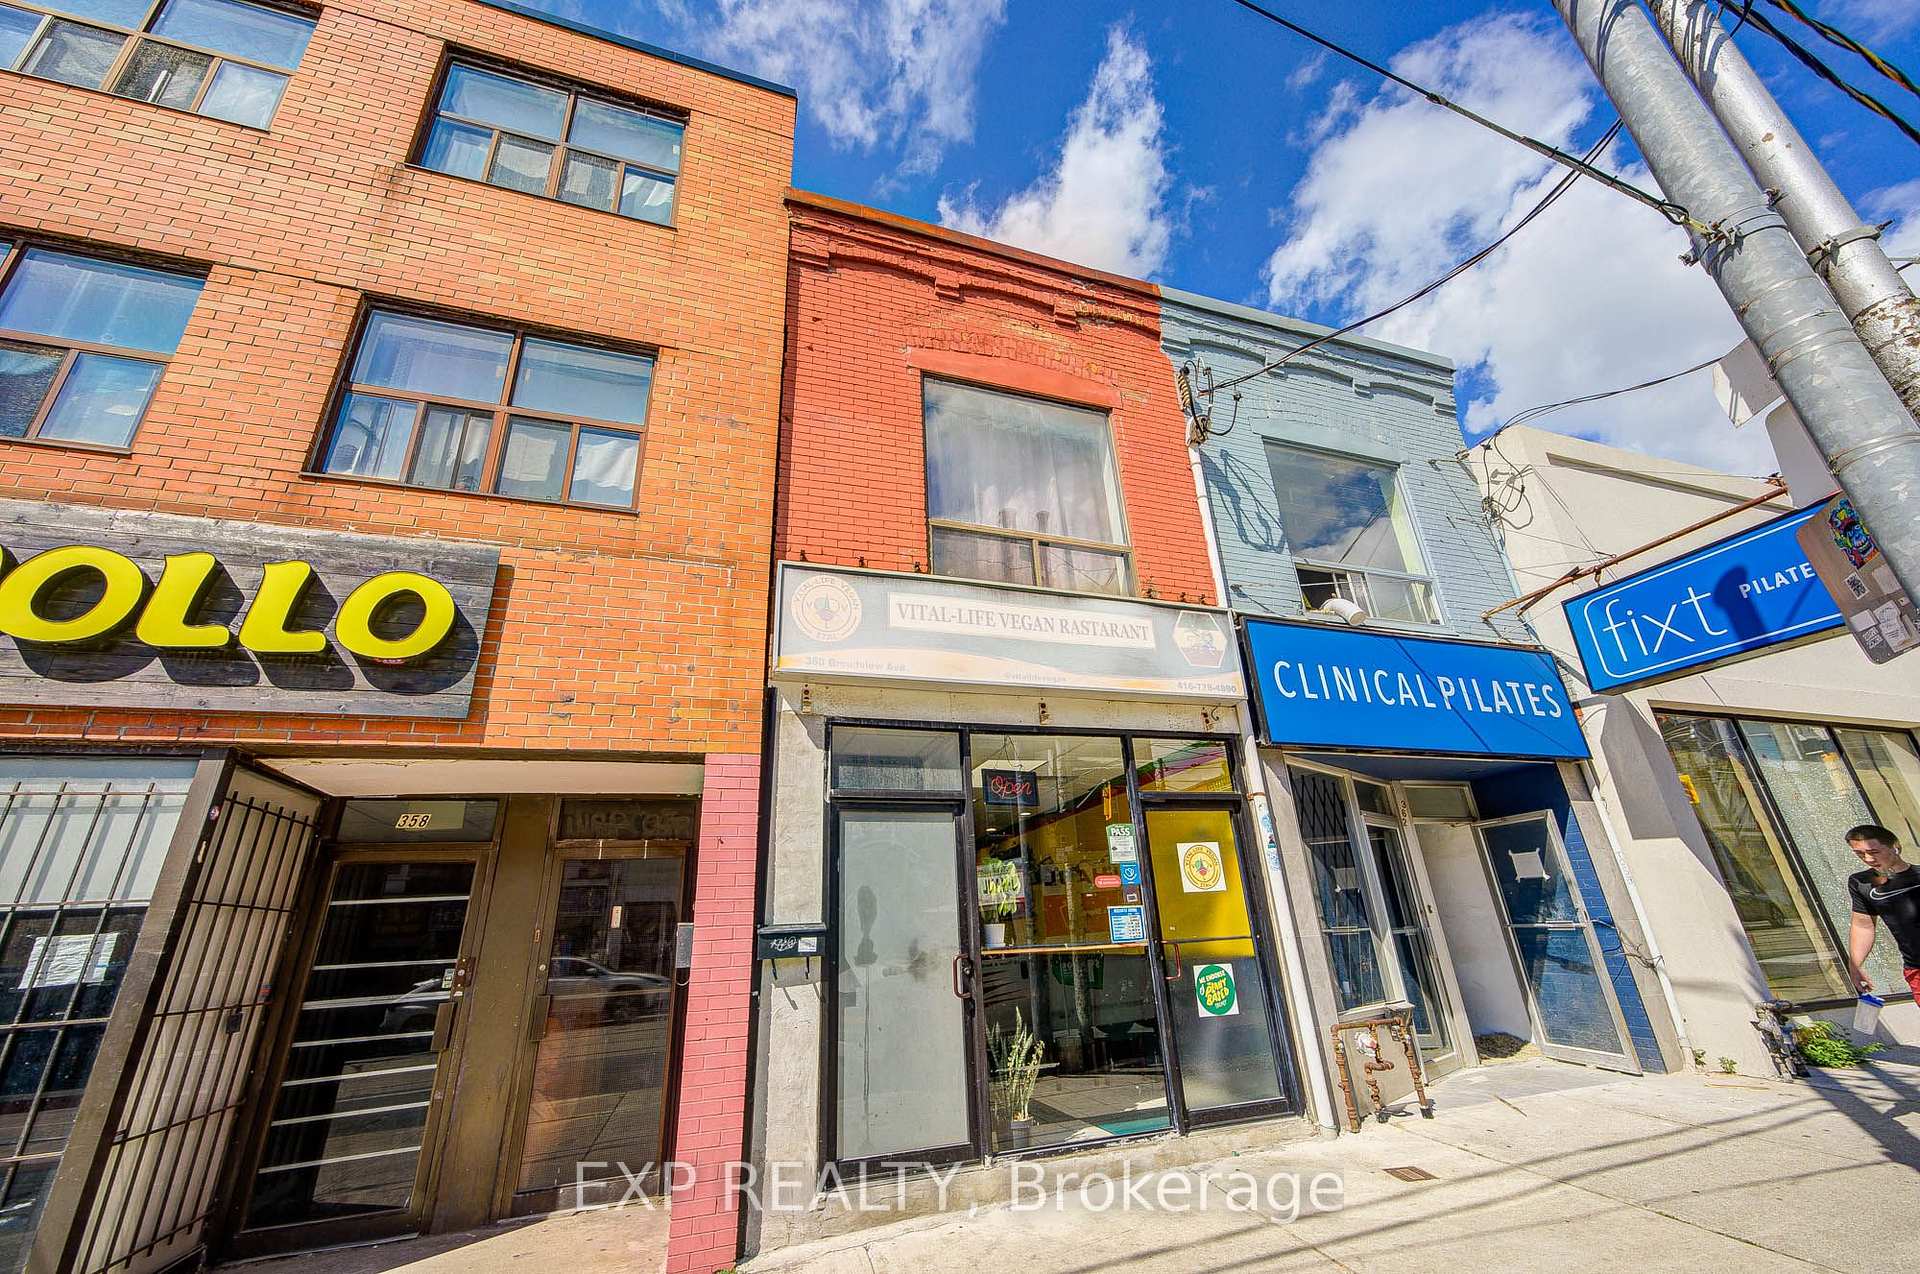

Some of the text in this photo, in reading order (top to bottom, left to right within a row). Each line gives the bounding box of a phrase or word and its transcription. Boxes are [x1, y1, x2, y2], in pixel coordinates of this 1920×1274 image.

[1738, 562, 1818, 599] PILATE
[0, 544, 457, 660] OLLO
[896, 602, 1149, 642] VITAL-LIFE VEGAN RASTARANT
[1602, 586, 1728, 662] fixt
[1273, 660, 1562, 719] CLINICAL PILATES
[991, 776, 1032, 799] Open
[398, 815, 429, 827] 358
[1111, 827, 1130, 836] PASS
